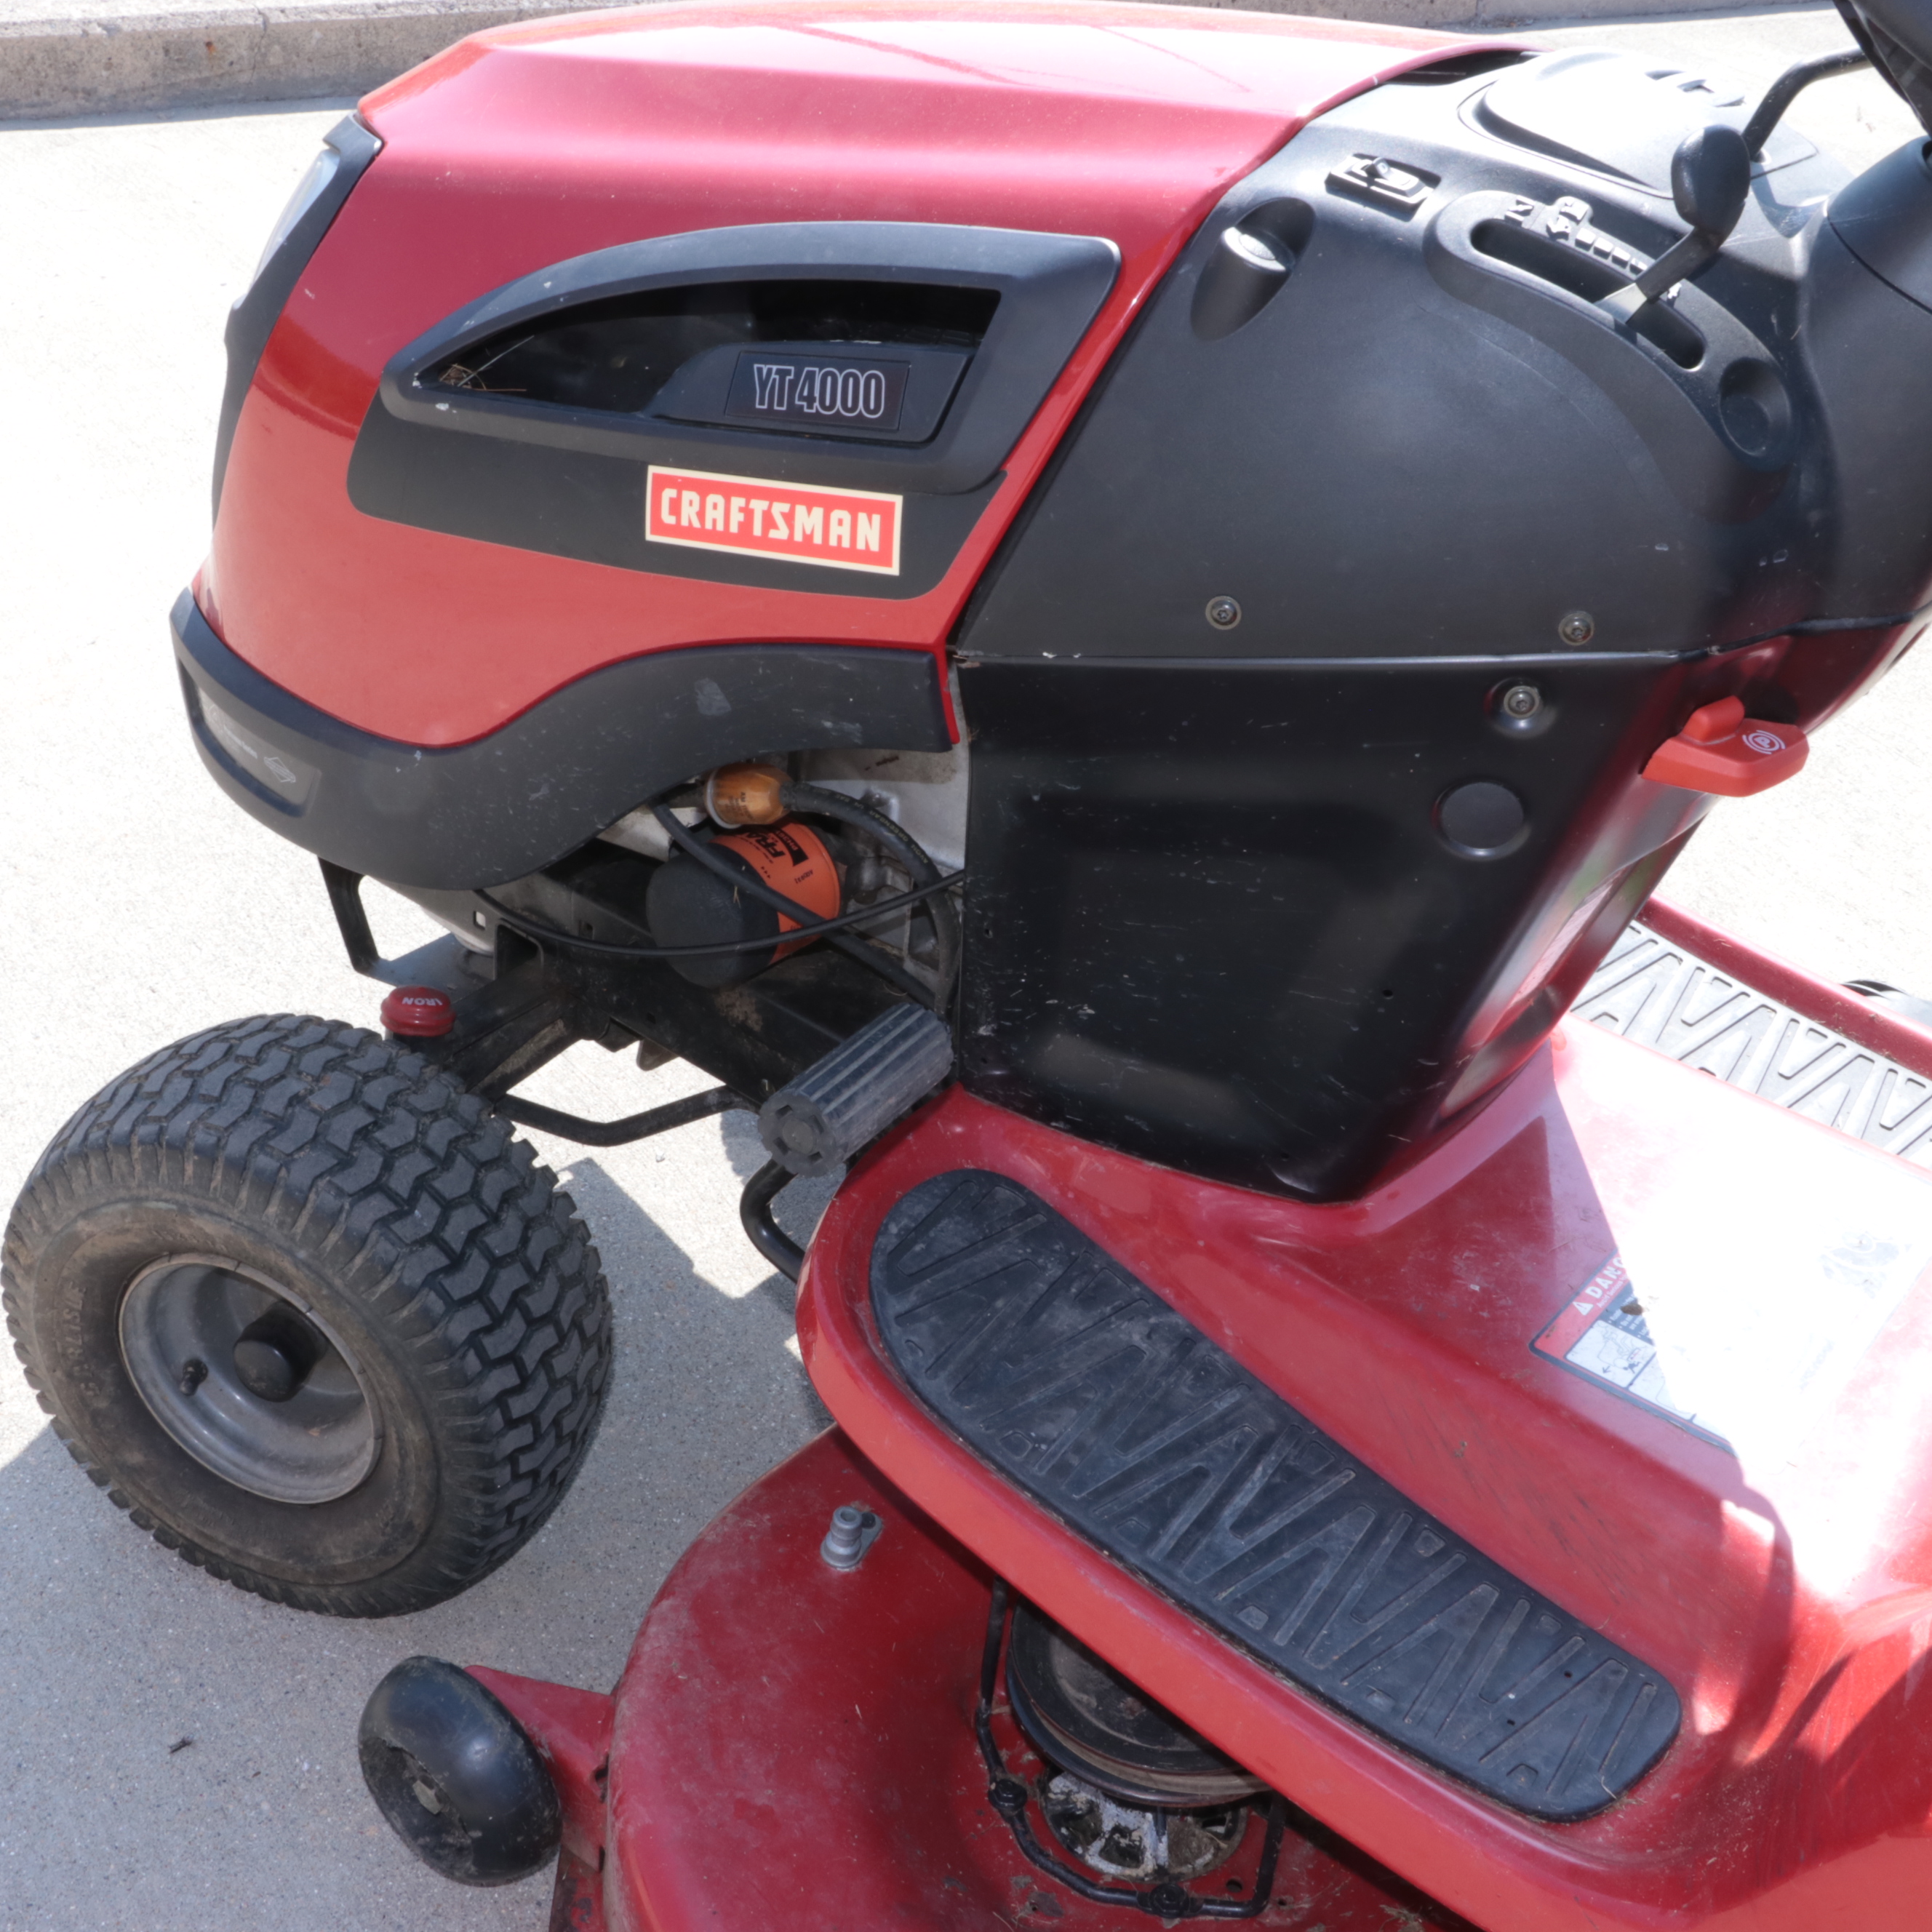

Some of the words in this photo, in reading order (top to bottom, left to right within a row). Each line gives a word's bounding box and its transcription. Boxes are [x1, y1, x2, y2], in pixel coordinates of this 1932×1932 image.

[754, 364, 794, 411] YT
[795, 367, 885, 418] 4000
[660, 487, 881, 552] CRAFTSMAN
[402, 997, 443, 1006] IRON
